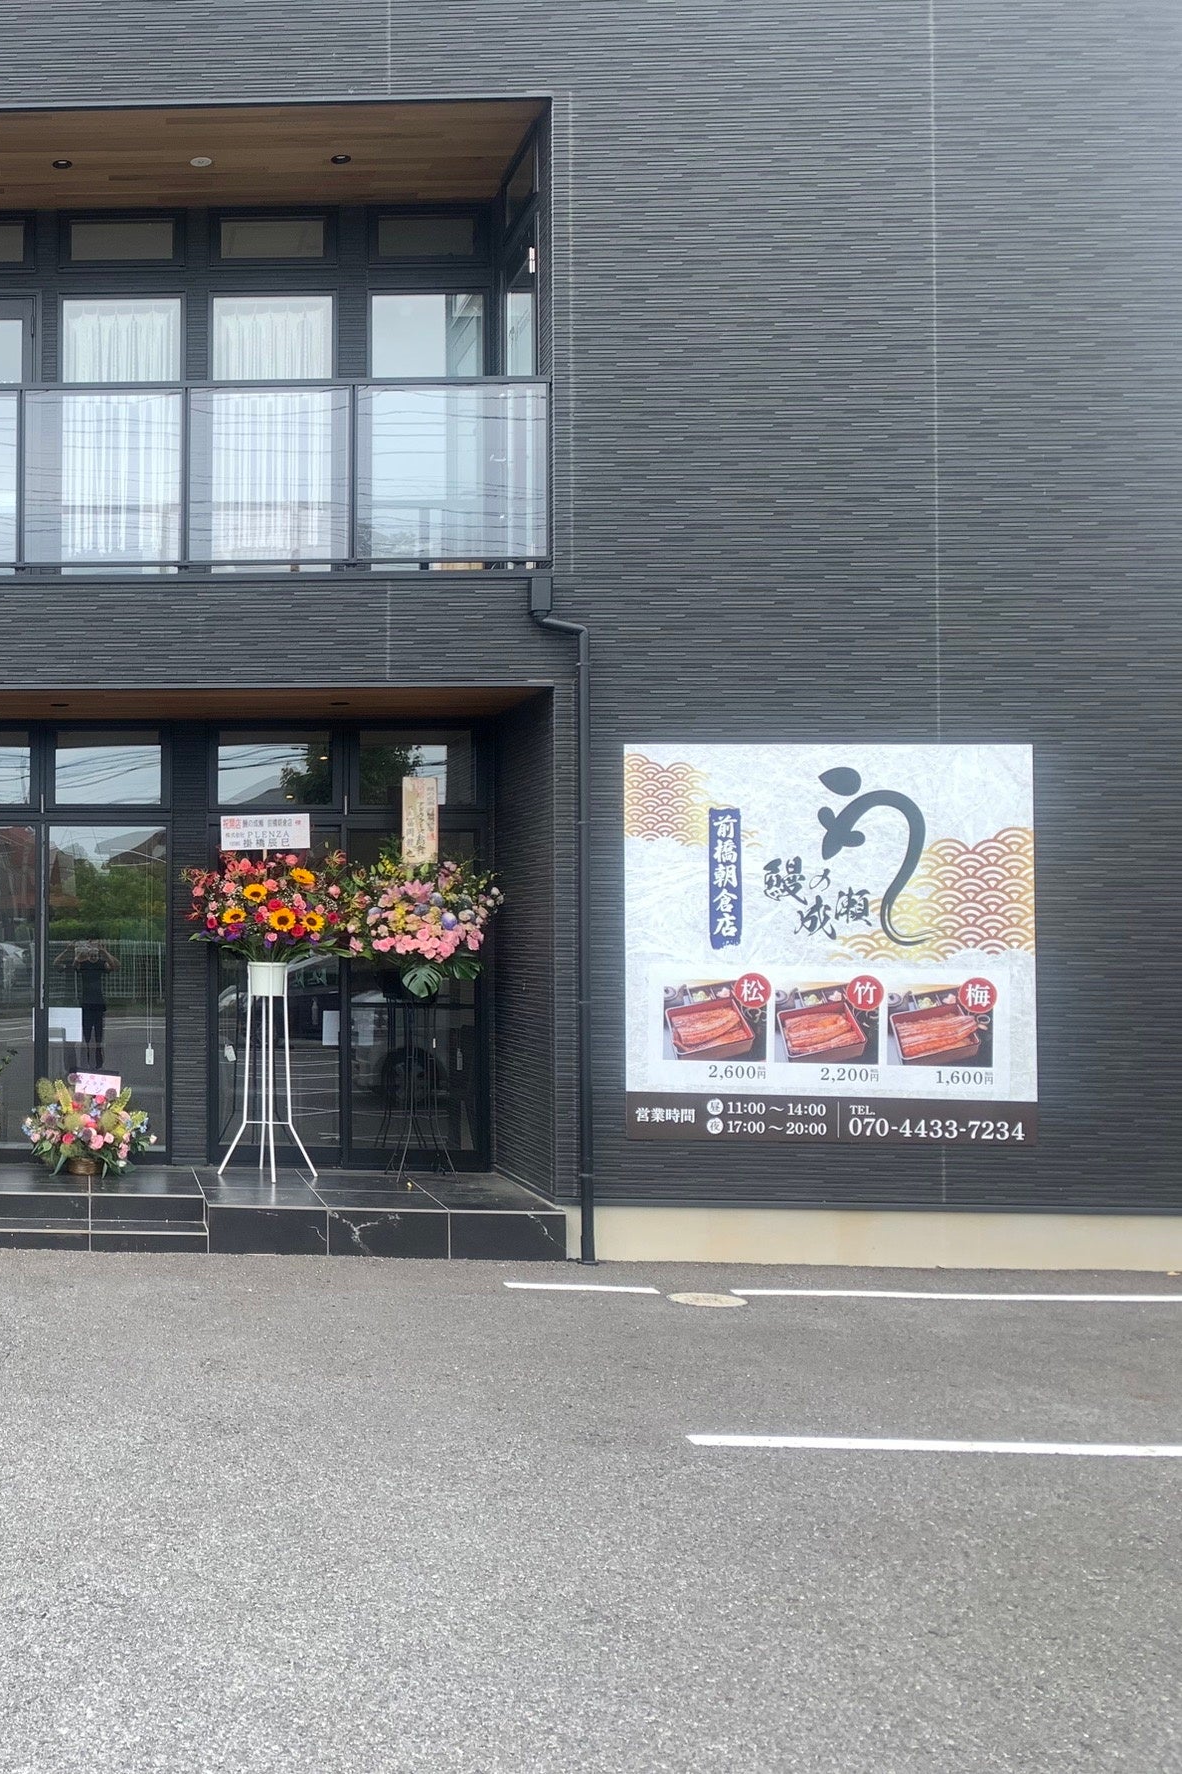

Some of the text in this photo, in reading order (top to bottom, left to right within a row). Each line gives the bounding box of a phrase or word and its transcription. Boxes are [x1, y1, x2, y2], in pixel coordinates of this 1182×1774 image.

[247, 830, 290, 839] PLENZA
[713, 814, 739, 938] 前橋朝倉店
[740, 979, 765, 1002] 松
[853, 981, 878, 1005] 竹
[966, 984, 991, 1007] 梅
[635, 1107, 696, 1123] 営業時間
[849, 1105, 876, 1116] TEL.
[848, 1117, 1026, 1141] 070-4433-7234
